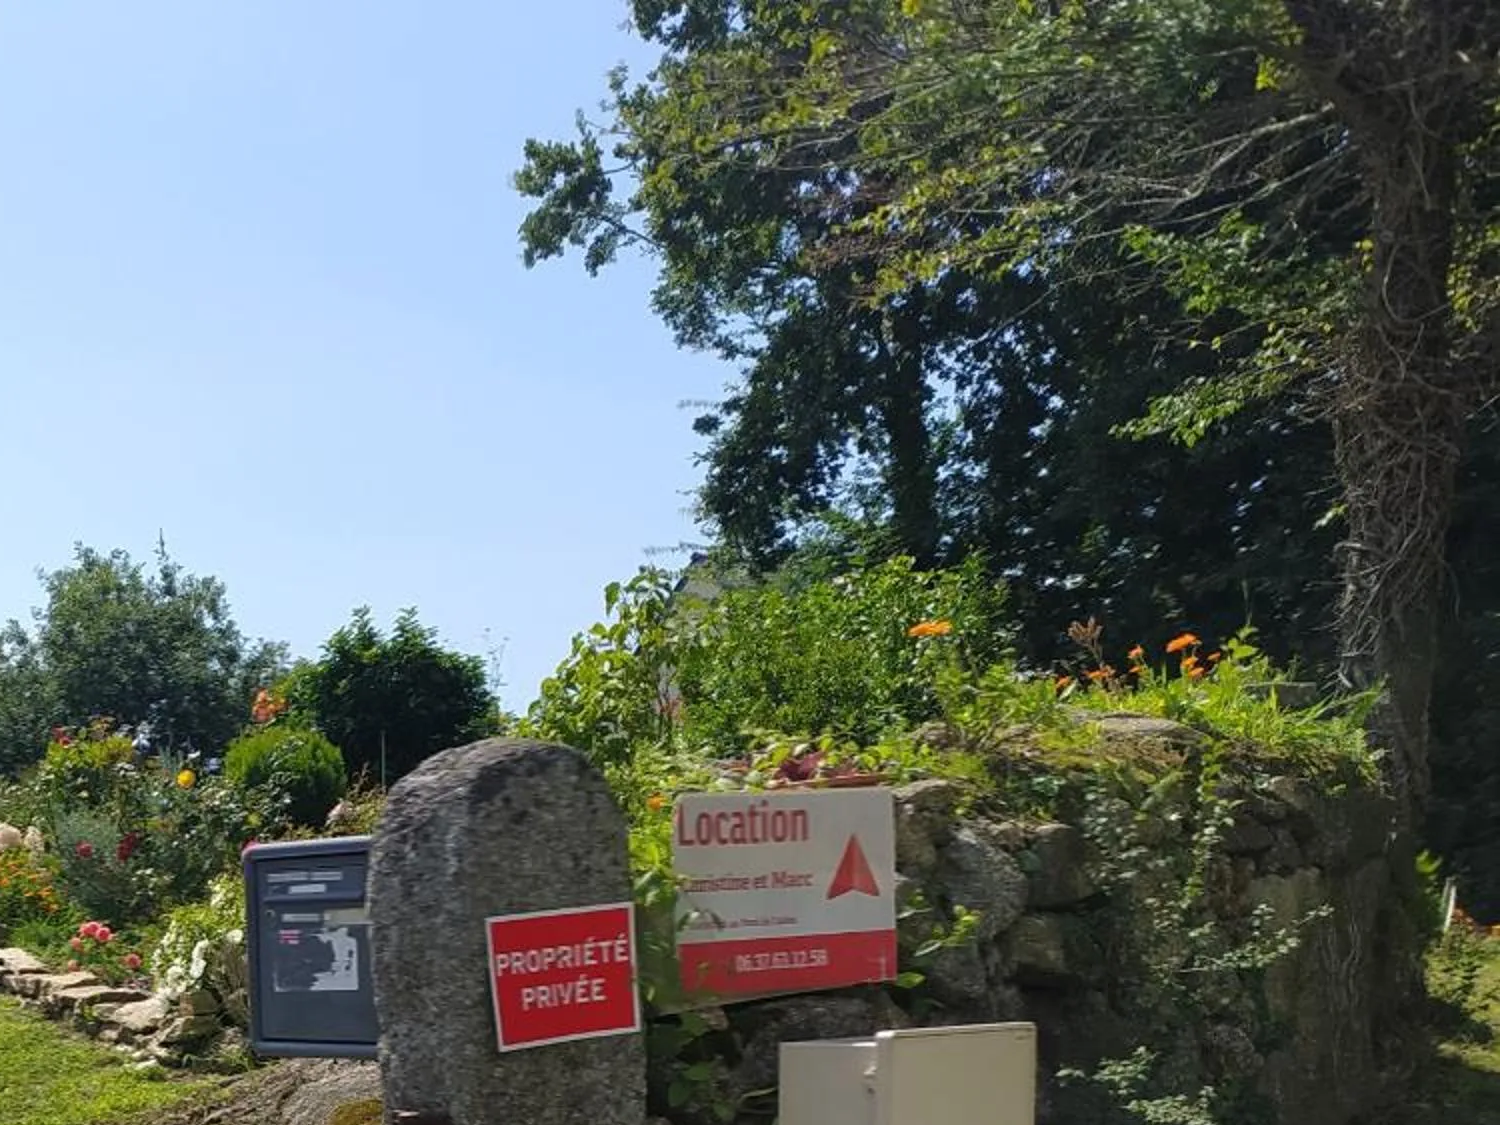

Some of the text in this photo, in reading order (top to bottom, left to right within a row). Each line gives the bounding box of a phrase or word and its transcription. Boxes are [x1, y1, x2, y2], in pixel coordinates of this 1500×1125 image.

[677, 800, 810, 846] Location
[495, 932, 629, 977] PROPRIÉTÉ
[521, 974, 608, 1011] PRIVÉE
